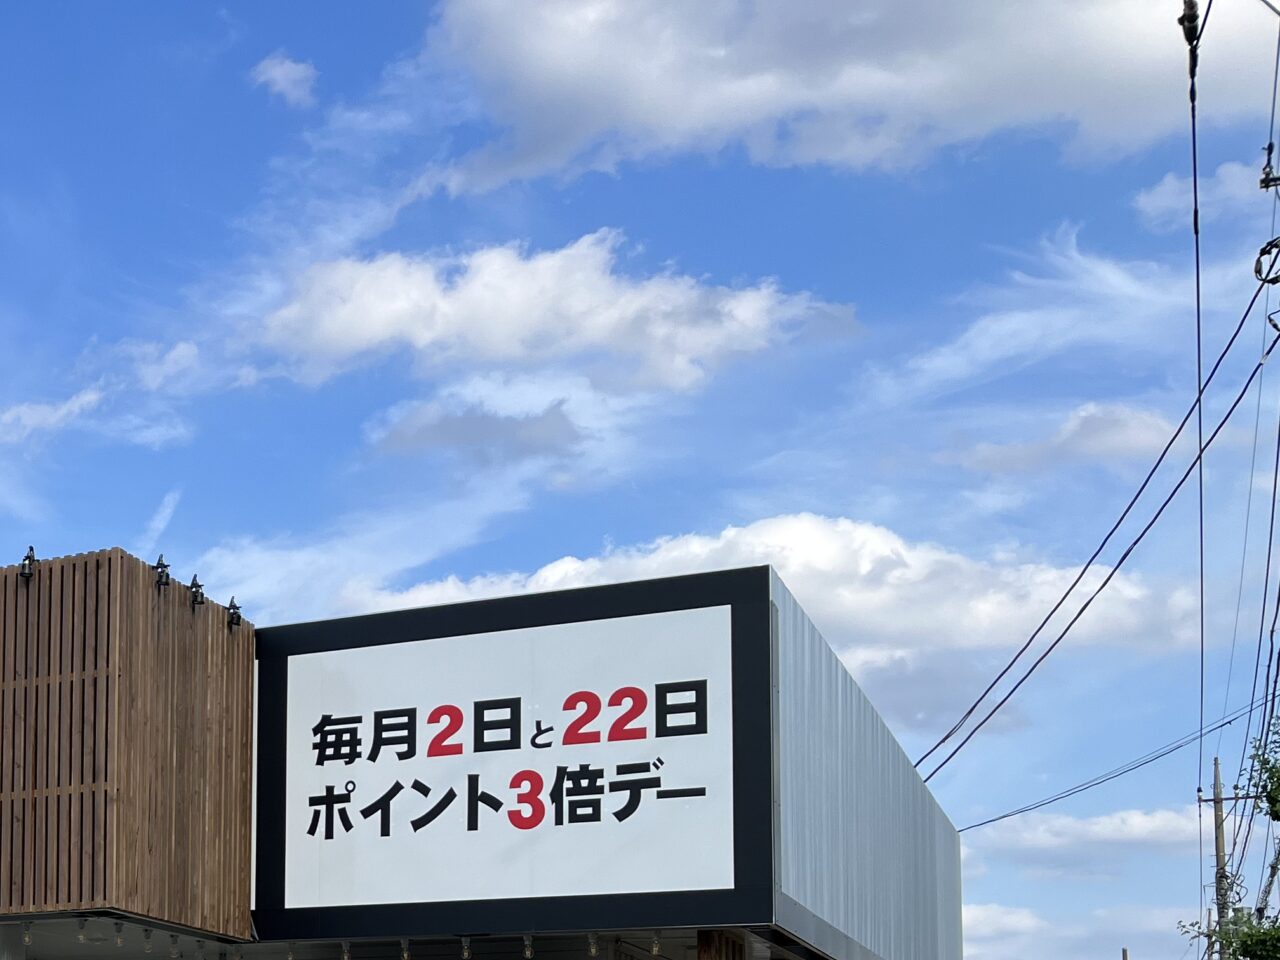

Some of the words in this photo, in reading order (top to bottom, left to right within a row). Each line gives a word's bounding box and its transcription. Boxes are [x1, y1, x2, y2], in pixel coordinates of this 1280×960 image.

[311, 679, 708, 766] 毎月2日と22日
[307, 757, 706, 840] ポイント3倍デー
